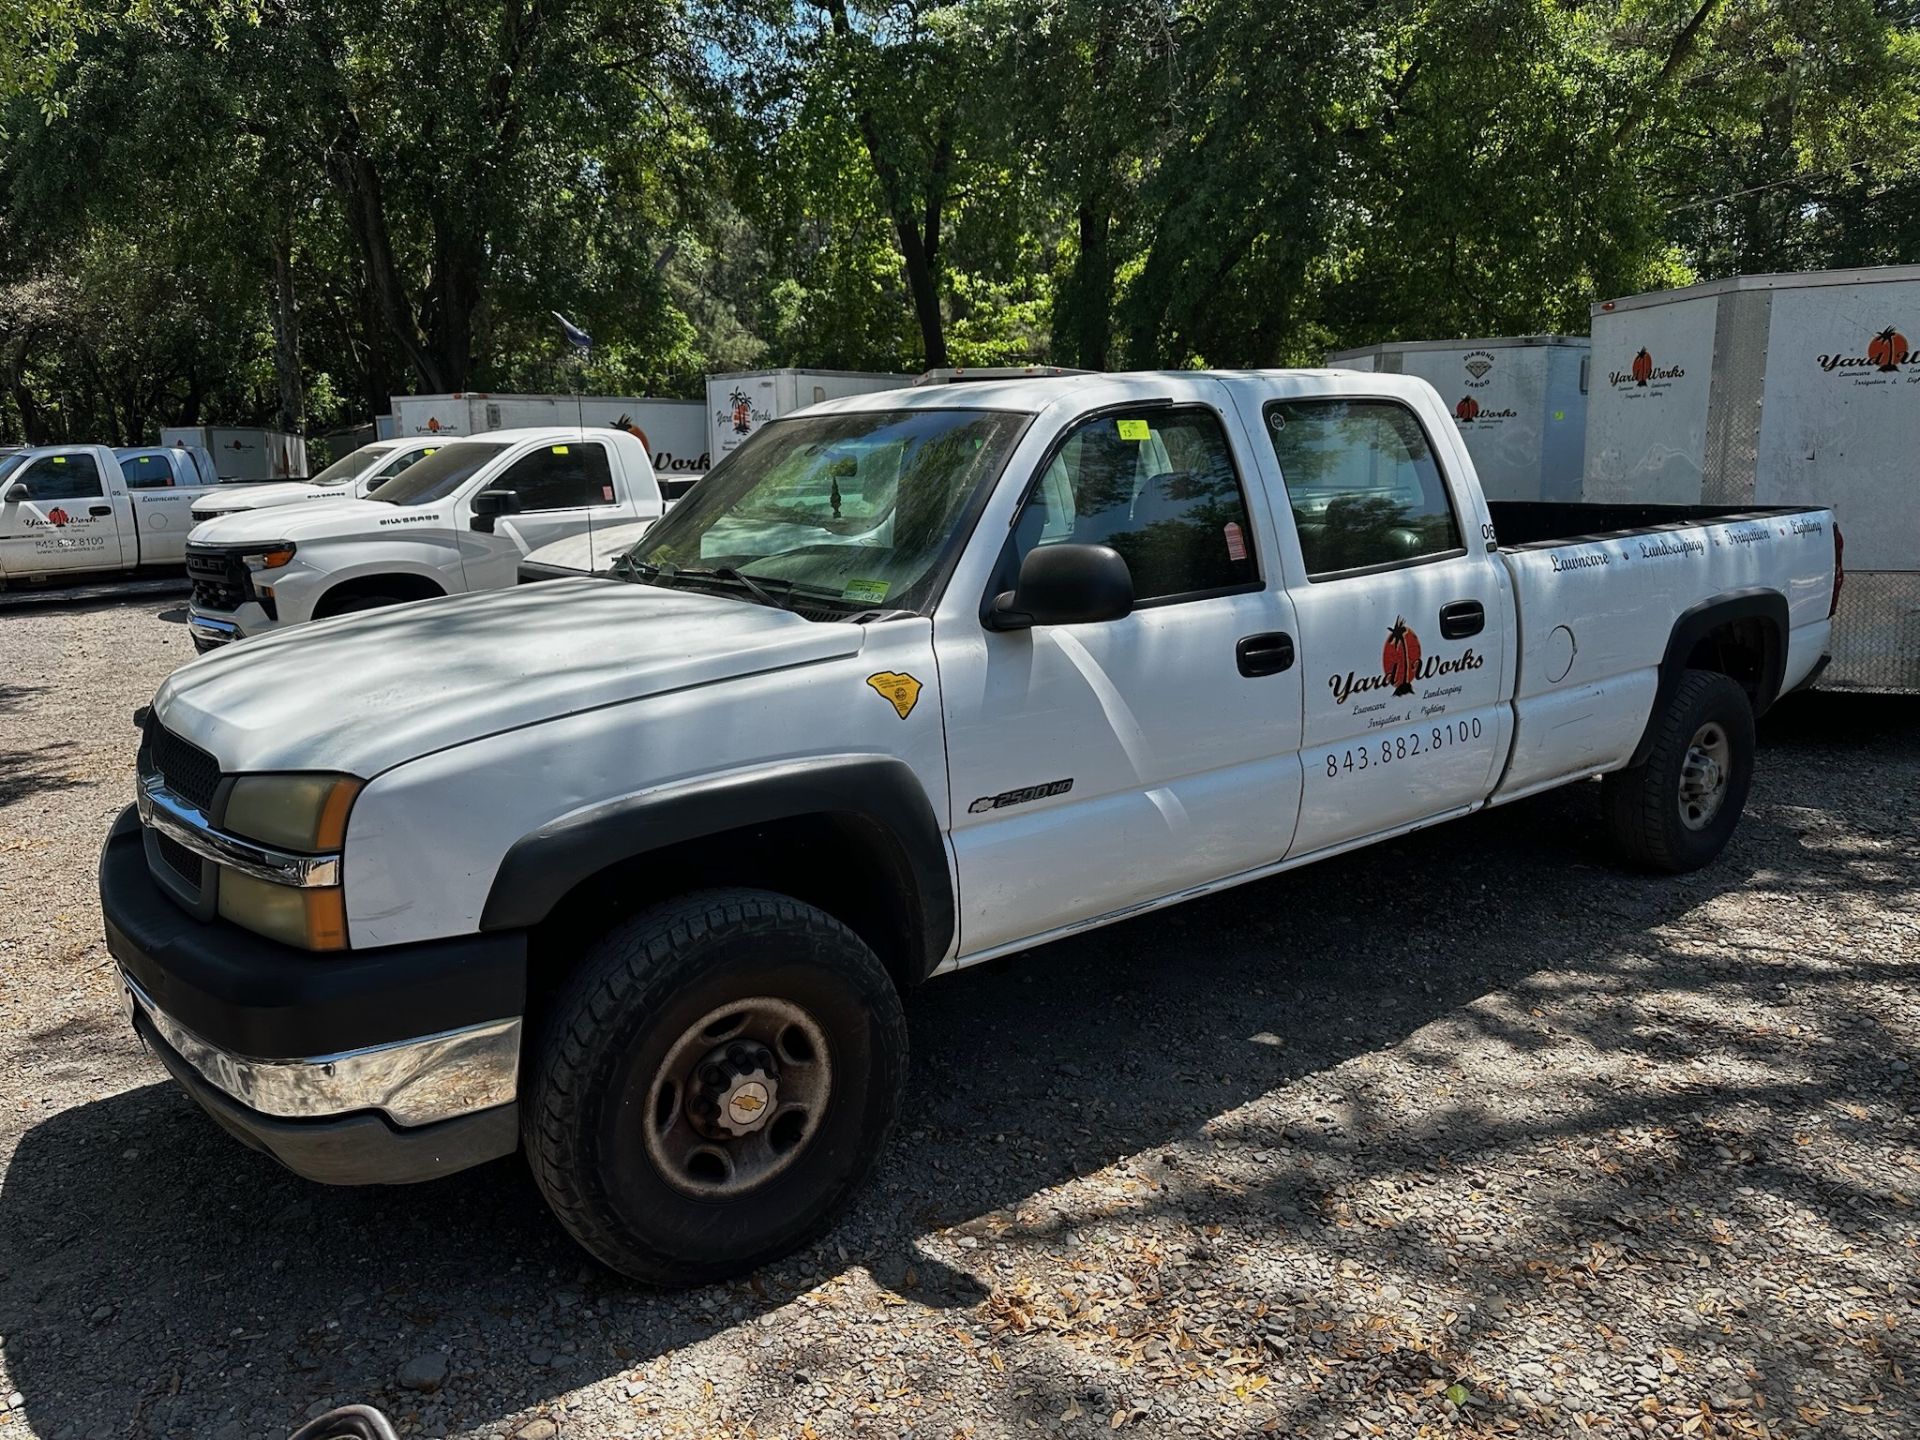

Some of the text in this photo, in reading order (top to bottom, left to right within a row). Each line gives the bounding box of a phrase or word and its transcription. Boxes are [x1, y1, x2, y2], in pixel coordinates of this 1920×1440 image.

[1463, 350, 1495, 361] DIAMOND
[1816, 353, 1884, 372] Yard
[1464, 379, 1490, 388] CARGO
[1608, 370, 1640, 387] Yard
[1648, 365, 1685, 381] Works
[1474, 409, 1517, 419] Works
[651, 452, 711, 471] Work
[1551, 519, 1822, 573] Lawncare Landscaping Irrigation Lighting
[1329, 648, 1484, 704] Yard Works
[1352, 685, 1462, 715] Lawncare Landscaping
[1368, 714, 1400, 728] Irrigation
[1326, 717, 1482, 778] 843.882.8100
[997, 781, 1073, 807] 2500 HD
